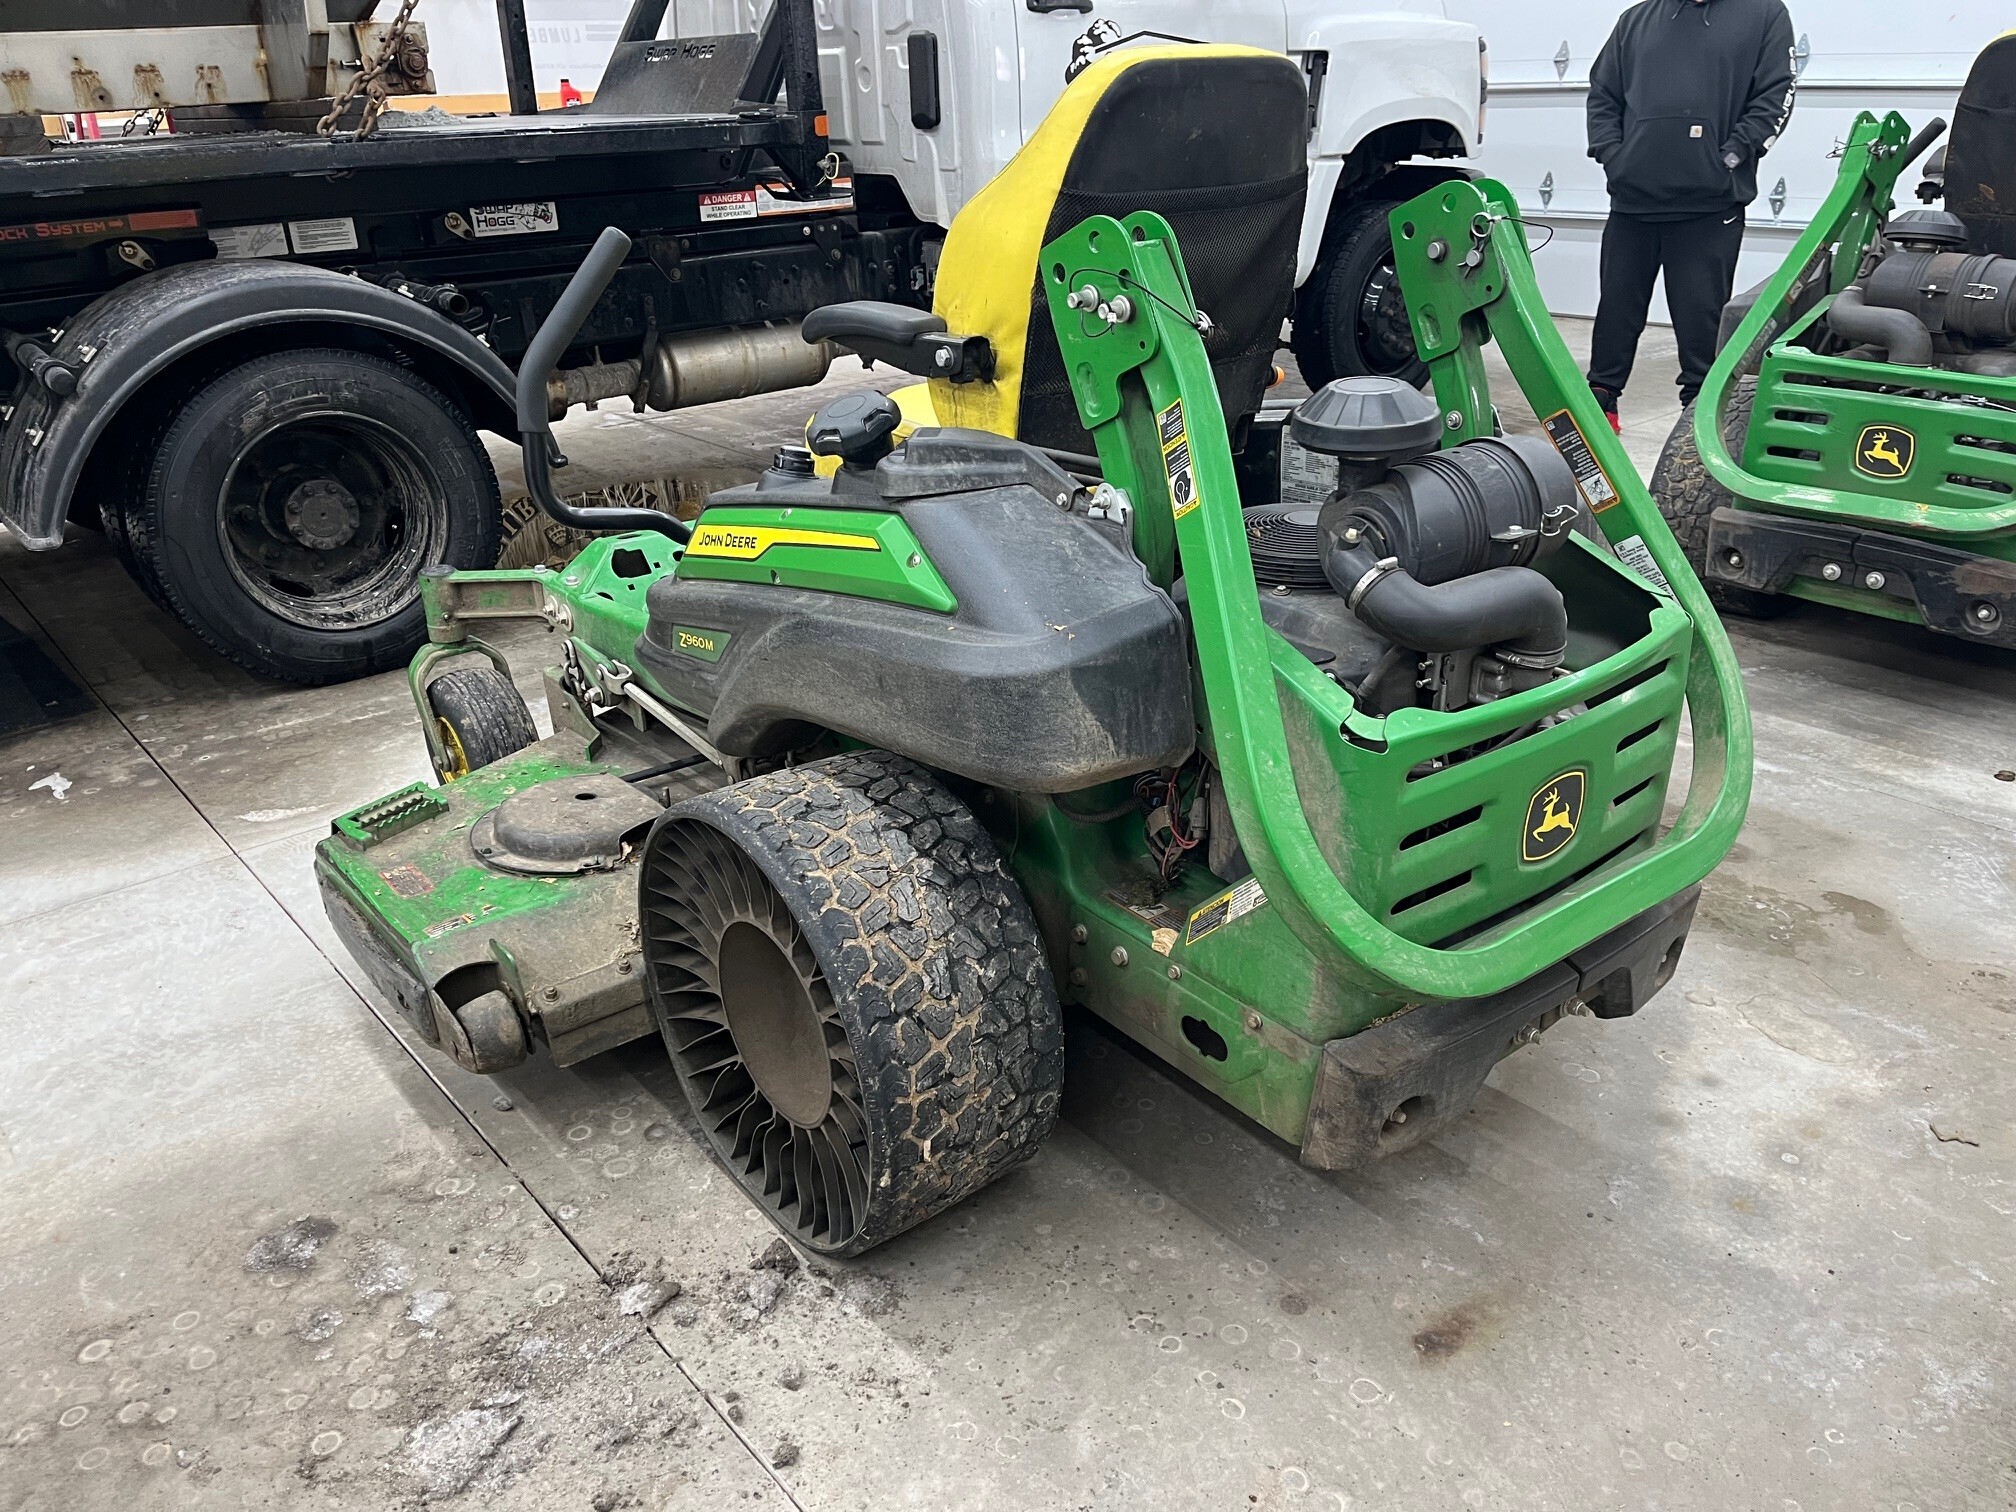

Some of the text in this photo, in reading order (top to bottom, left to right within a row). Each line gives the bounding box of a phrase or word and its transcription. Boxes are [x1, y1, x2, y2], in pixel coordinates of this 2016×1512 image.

[711, 194, 743, 204] DANGER
[35, 221, 105, 238] SYSTEM
[476, 215, 515, 228] HOGG
[699, 532, 758, 550] JOHN DEERE
[678, 632, 714, 652] Z960M
